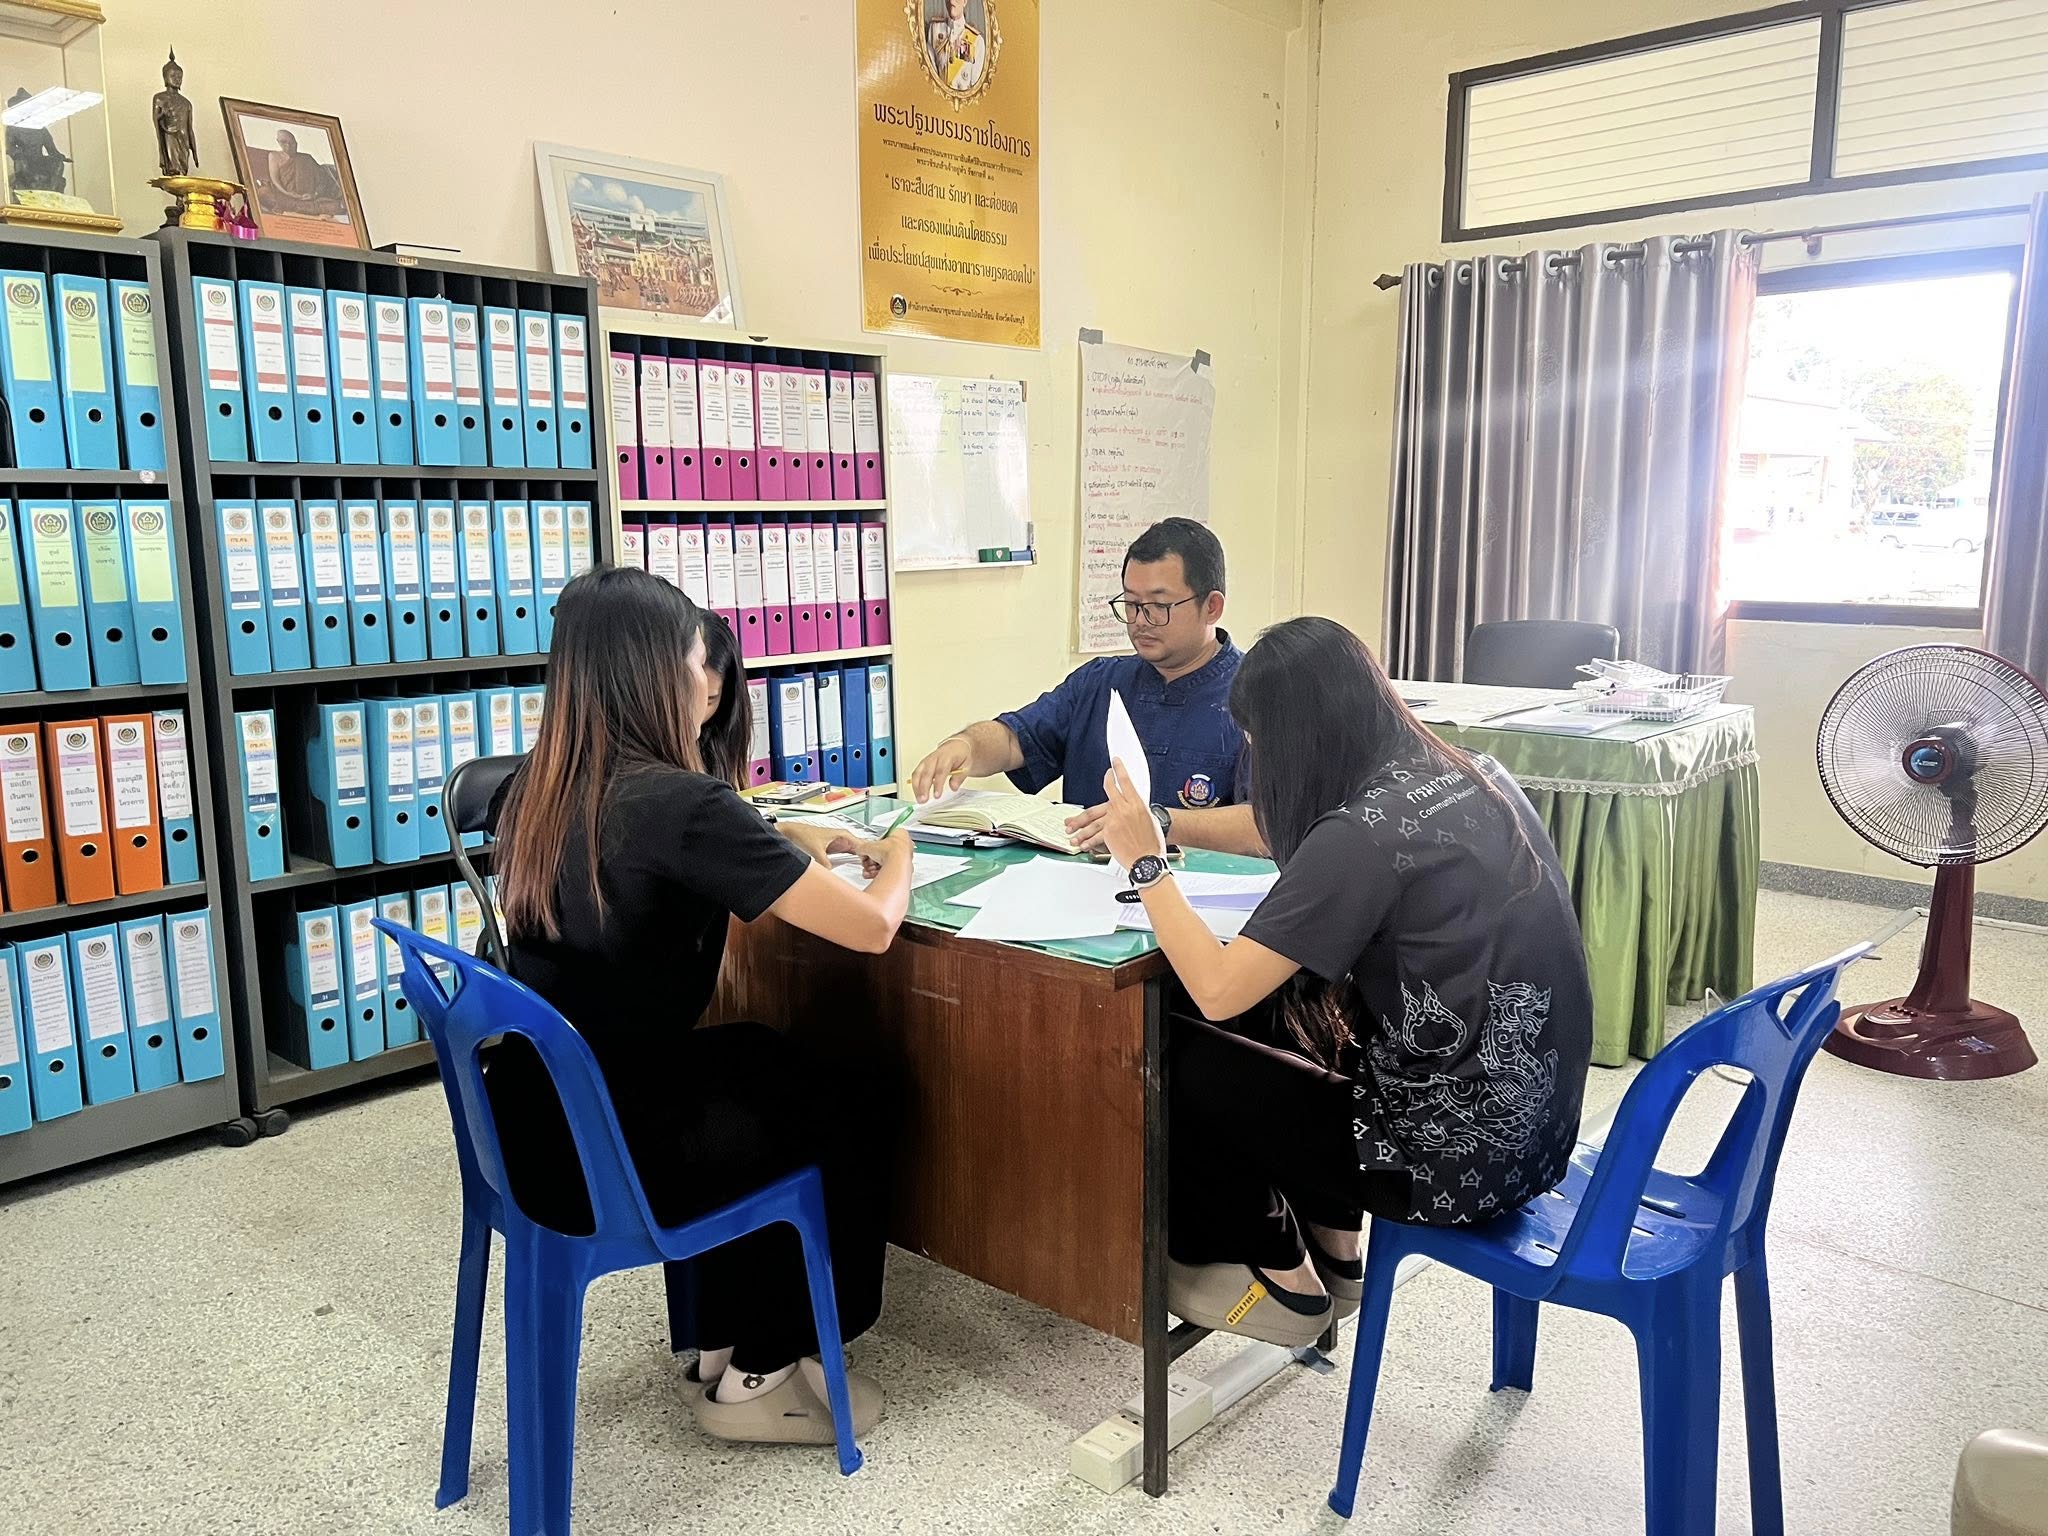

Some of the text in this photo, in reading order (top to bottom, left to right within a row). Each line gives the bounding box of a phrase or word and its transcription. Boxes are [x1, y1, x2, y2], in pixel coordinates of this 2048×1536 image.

[874, 102, 1031, 158] พระปฐมบรมราชโองการ
[948, 184, 972, 205] รักษา
[975, 193, 1018, 214] และต่อยอด
[901, 214, 1008, 246] และครองแผ่นดินโดยธรรม
[118, 799, 145, 807] โครงการ
[1418, 795, 1458, 819] Community
[10, 817, 38, 825] โครงการ
